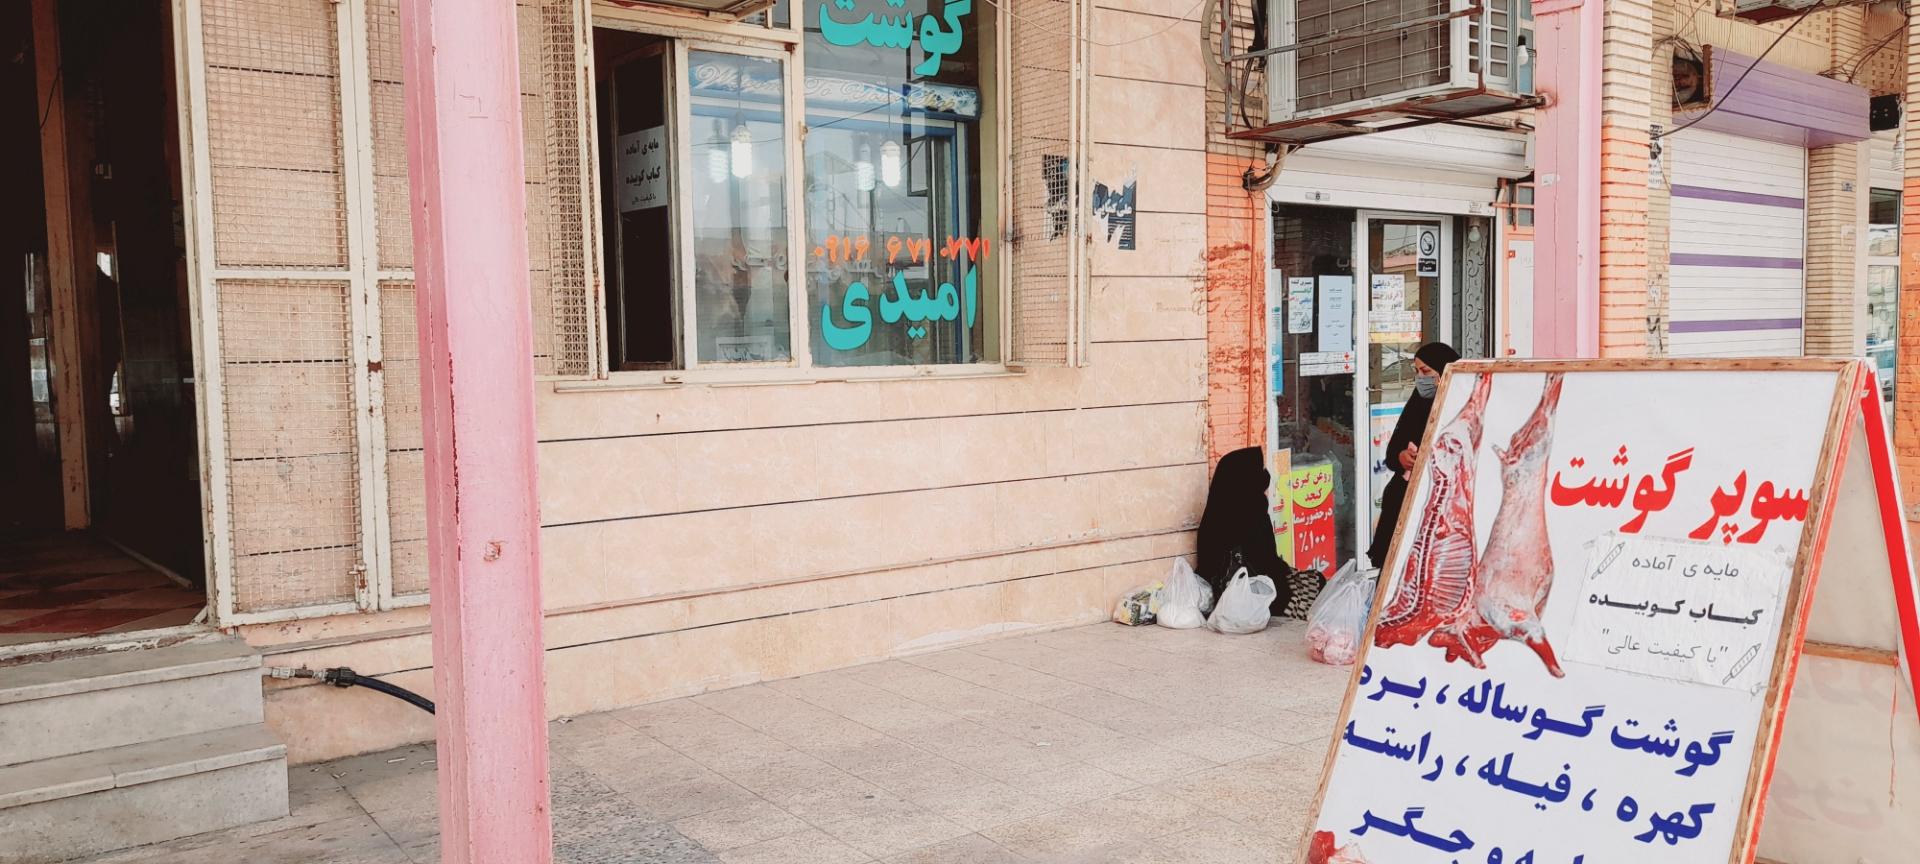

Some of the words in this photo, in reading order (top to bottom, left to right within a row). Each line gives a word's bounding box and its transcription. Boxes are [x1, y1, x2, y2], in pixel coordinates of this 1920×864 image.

[820, 0, 971, 77] گوشت
[626, 169, 645, 187] کوبیده
[646, 166, 661, 184] کباب
[821, 264, 977, 351] امیدی
[1550, 444, 1695, 534] گوشت
[1687, 469, 1811, 545] سوپر
[1632, 555, 1677, 571] آماده
[1683, 564, 1698, 578] ی
[1703, 562, 1739, 580] مایه
[1588, 593, 1686, 618] کوبیده
[1688, 602, 1764, 629] کباب
[1647, 642, 1702, 664] کیفیت
[1359, 664, 1428, 709] بره
[1342, 719, 1444, 783] راسته
[1610, 717, 1735, 777] گوشت
[1350, 806, 1475, 864] جگر
